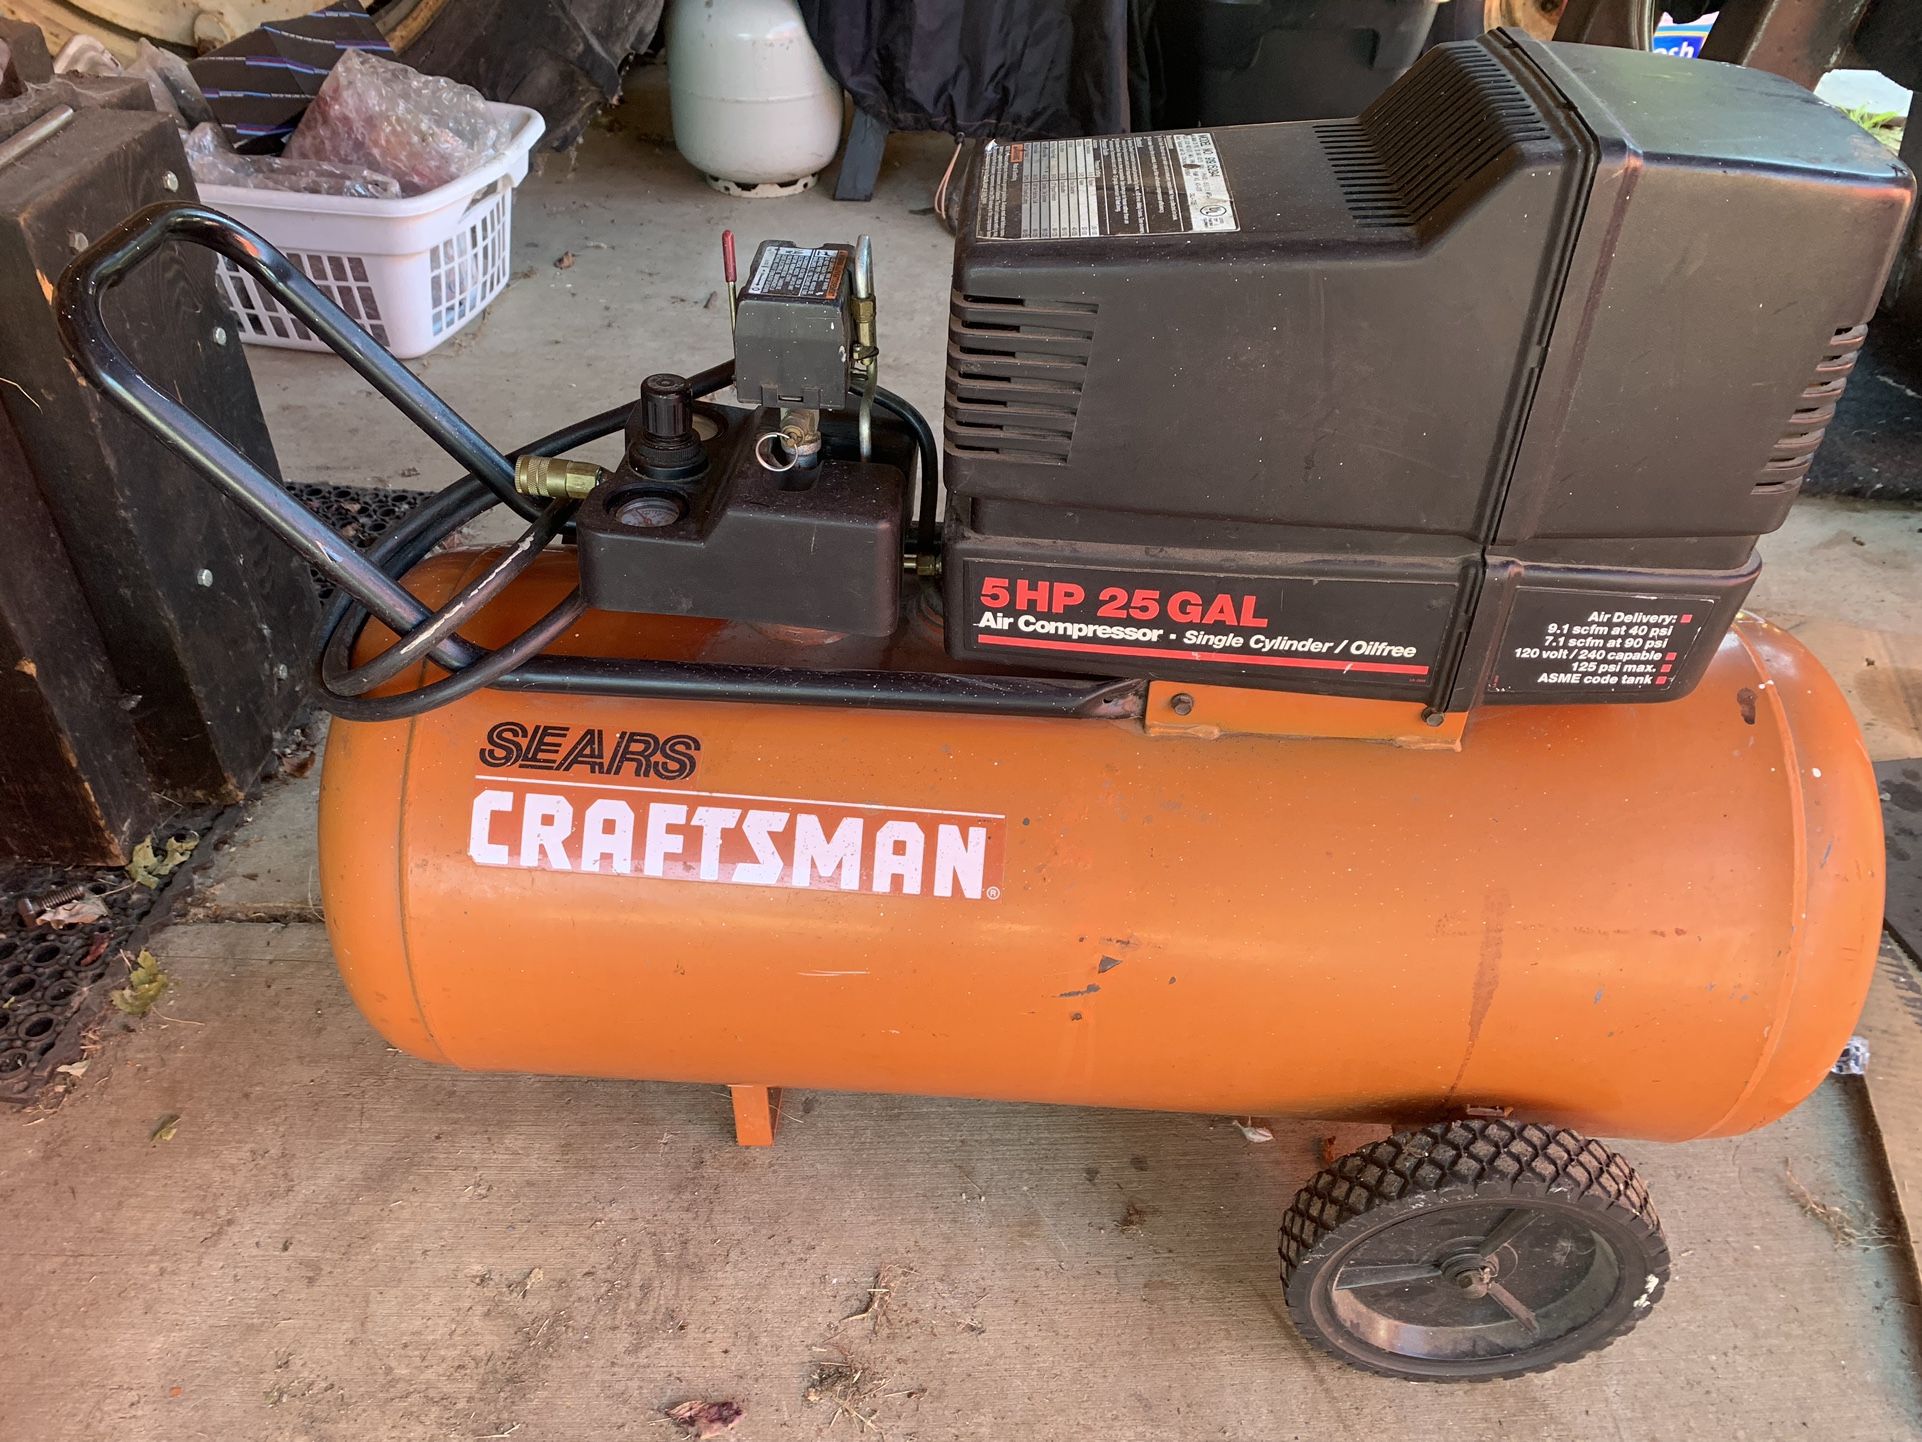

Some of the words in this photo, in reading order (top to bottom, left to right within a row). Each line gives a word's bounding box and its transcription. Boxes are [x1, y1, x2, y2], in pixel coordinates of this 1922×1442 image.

[1588, 611, 1611, 623] Air
[1613, 612, 1678, 625] Delivery:
[979, 611, 1013, 630] Air
[1017, 614, 1164, 641] Compressor
[1183, 630, 1244, 650] Single
[1249, 634, 1333, 654] Cylinder
[1350, 641, 1417, 659] Oilfree
[1548, 623, 1570, 635] 9.1
[1572, 624, 1609, 636] scfm
[1611, 625, 1627, 636] at
[1628, 625, 1648, 636] 40
[1649, 626, 1674, 639] psi
[1544, 636, 1565, 647] 7.1
[1568, 636, 1604, 648] scfm
[1606, 637, 1622, 648] at
[1624, 638, 1643, 649] 90
[1644, 638, 1669, 650] psi
[1514, 648, 1540, 659] 120
[1542, 648, 1568, 660] volt
[1578, 649, 1605, 660] 240
[1607, 650, 1663, 662] capable
[1571, 661, 1597, 672] 125
[1598, 662, 1622, 674] psi
[1623, 664, 1657, 673] max.
[1537, 672, 1582, 684] ASME
[1583, 673, 1619, 685] code
[1621, 674, 1653, 685] tank
[479, 721, 702, 781] SEARS
[469, 790, 987, 899] CRAFTSMAN
